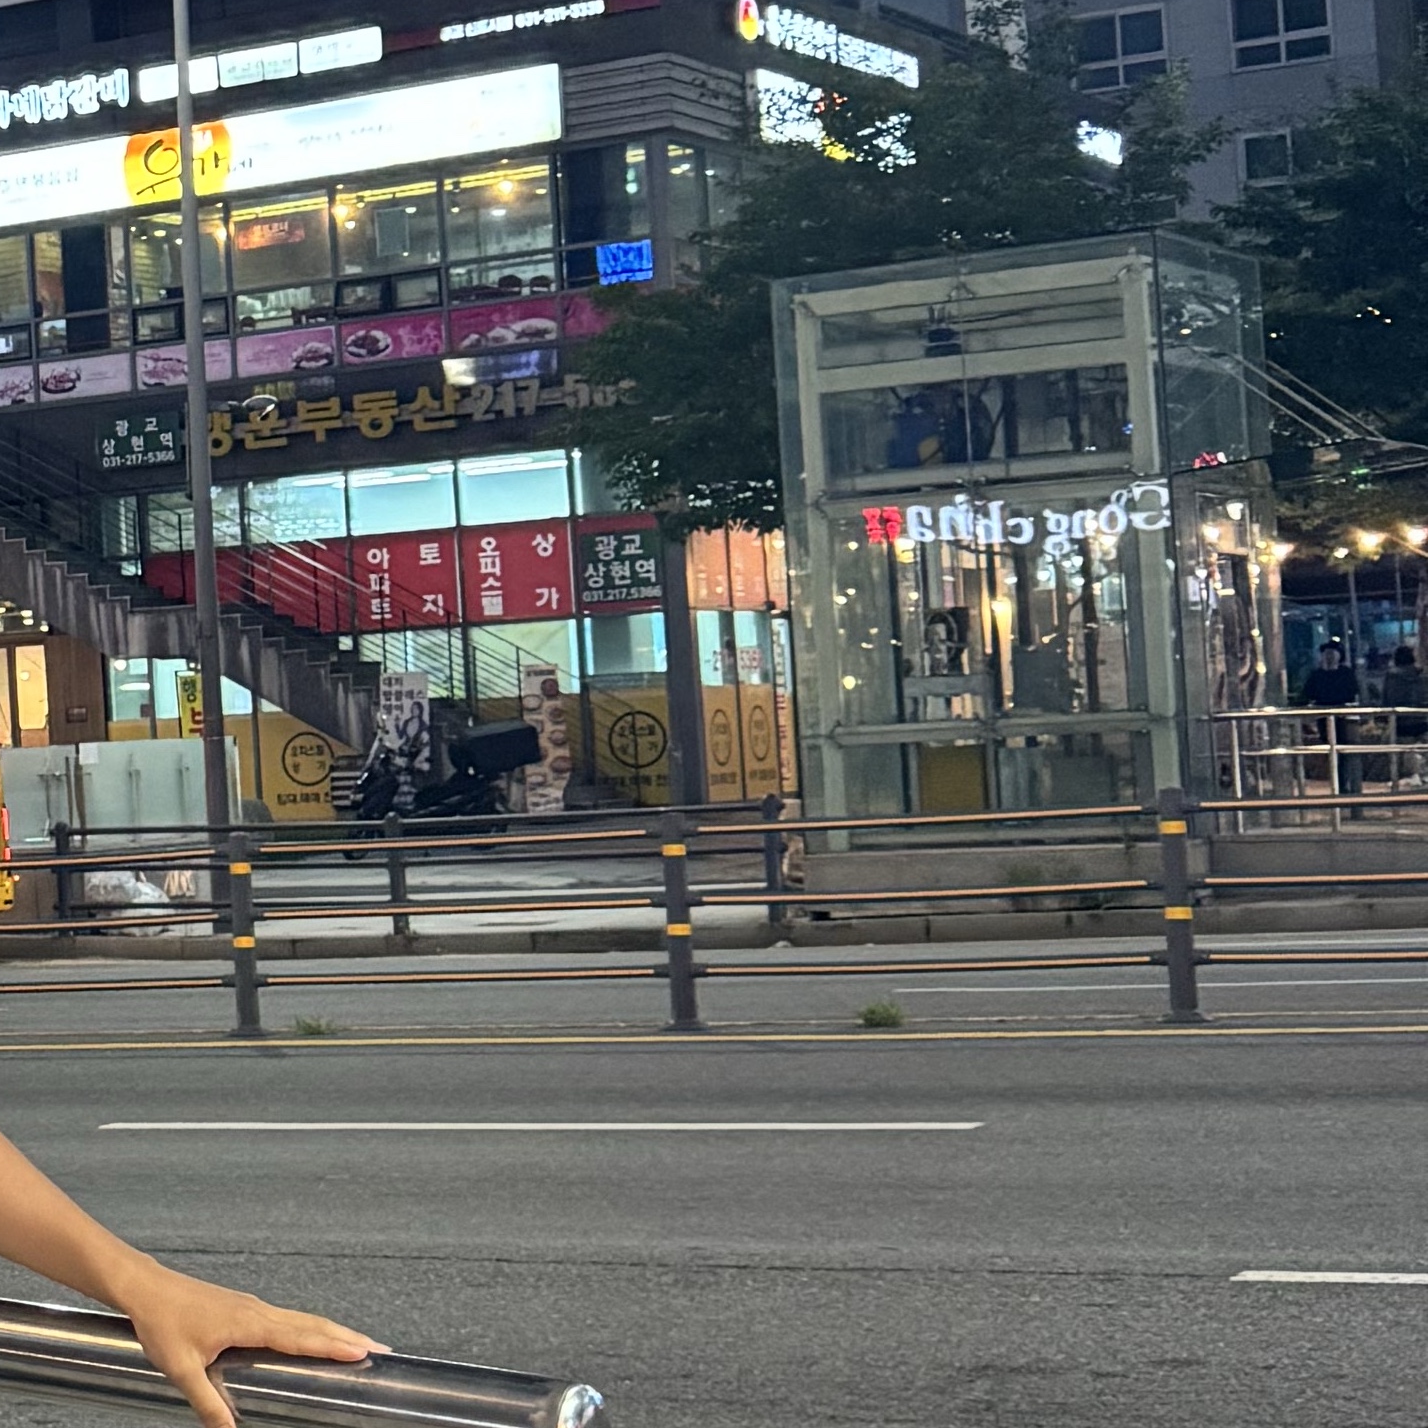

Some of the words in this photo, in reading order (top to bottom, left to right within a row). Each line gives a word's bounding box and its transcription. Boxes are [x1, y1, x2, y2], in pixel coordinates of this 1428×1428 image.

[115, 418, 159, 434] 광교
[102, 432, 174, 456] 상현역
[594, 534, 643, 560] 광교
[477, 536, 504, 616] 오피스텔
[584, 558, 657, 587] 상현역
